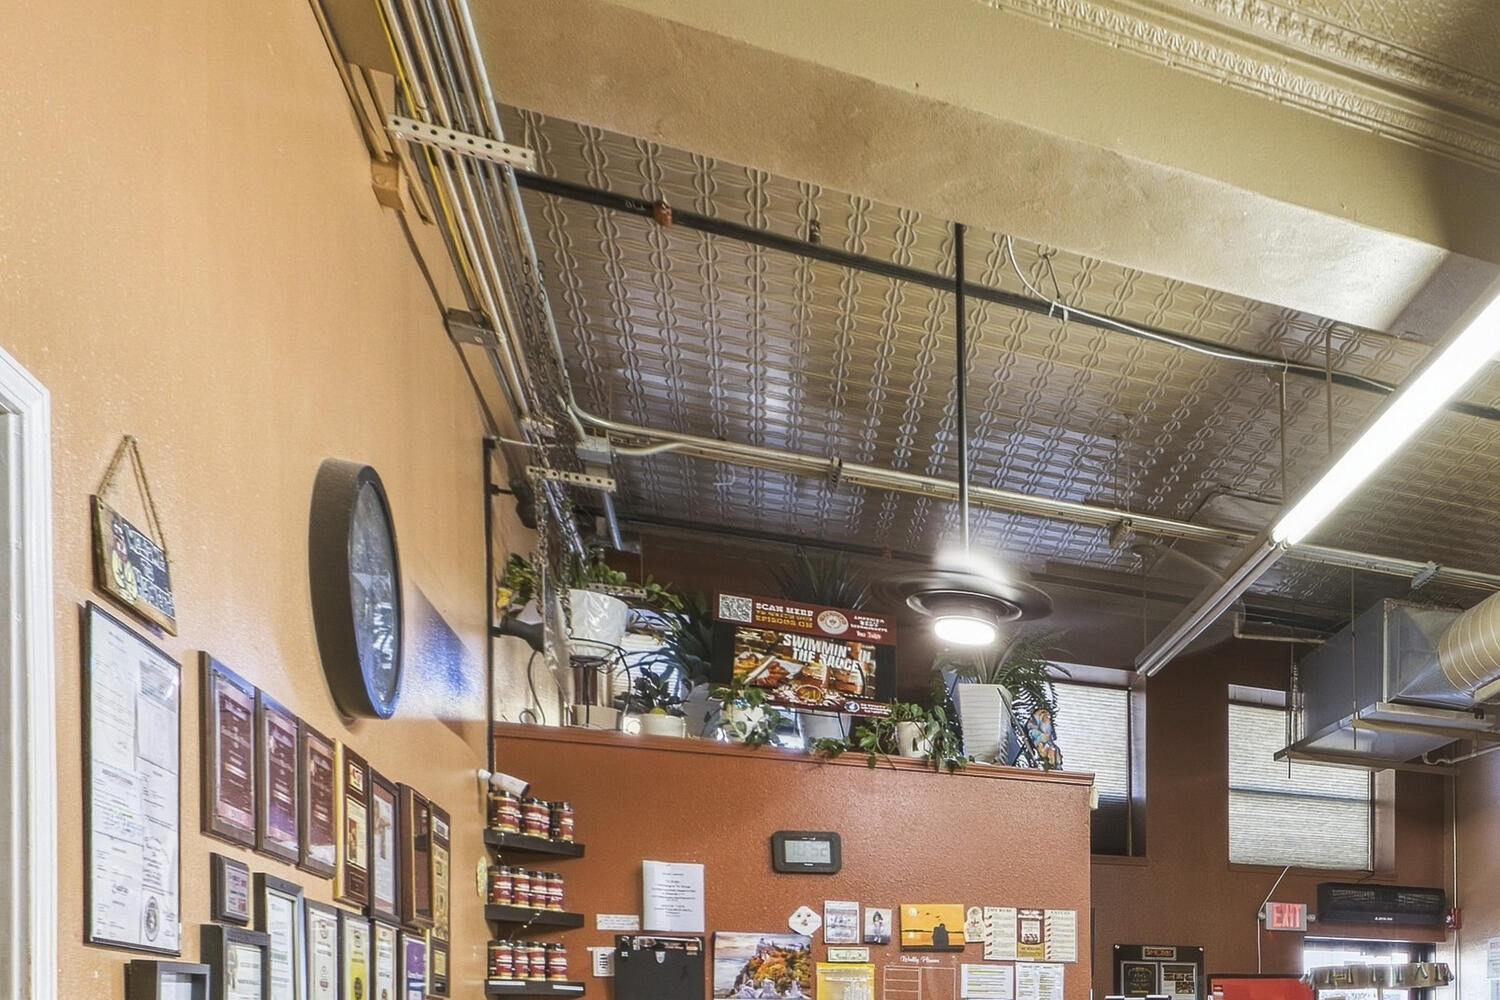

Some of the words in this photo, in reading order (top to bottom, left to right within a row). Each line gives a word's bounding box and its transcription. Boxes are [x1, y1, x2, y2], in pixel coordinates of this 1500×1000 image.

[756, 602, 784, 613] SCAN
[783, 634, 852, 658] SWIMMIN'
[793, 648, 817, 663] THE
[819, 652, 861, 673] SAUCE
[1272, 903, 1302, 929] EXIT
